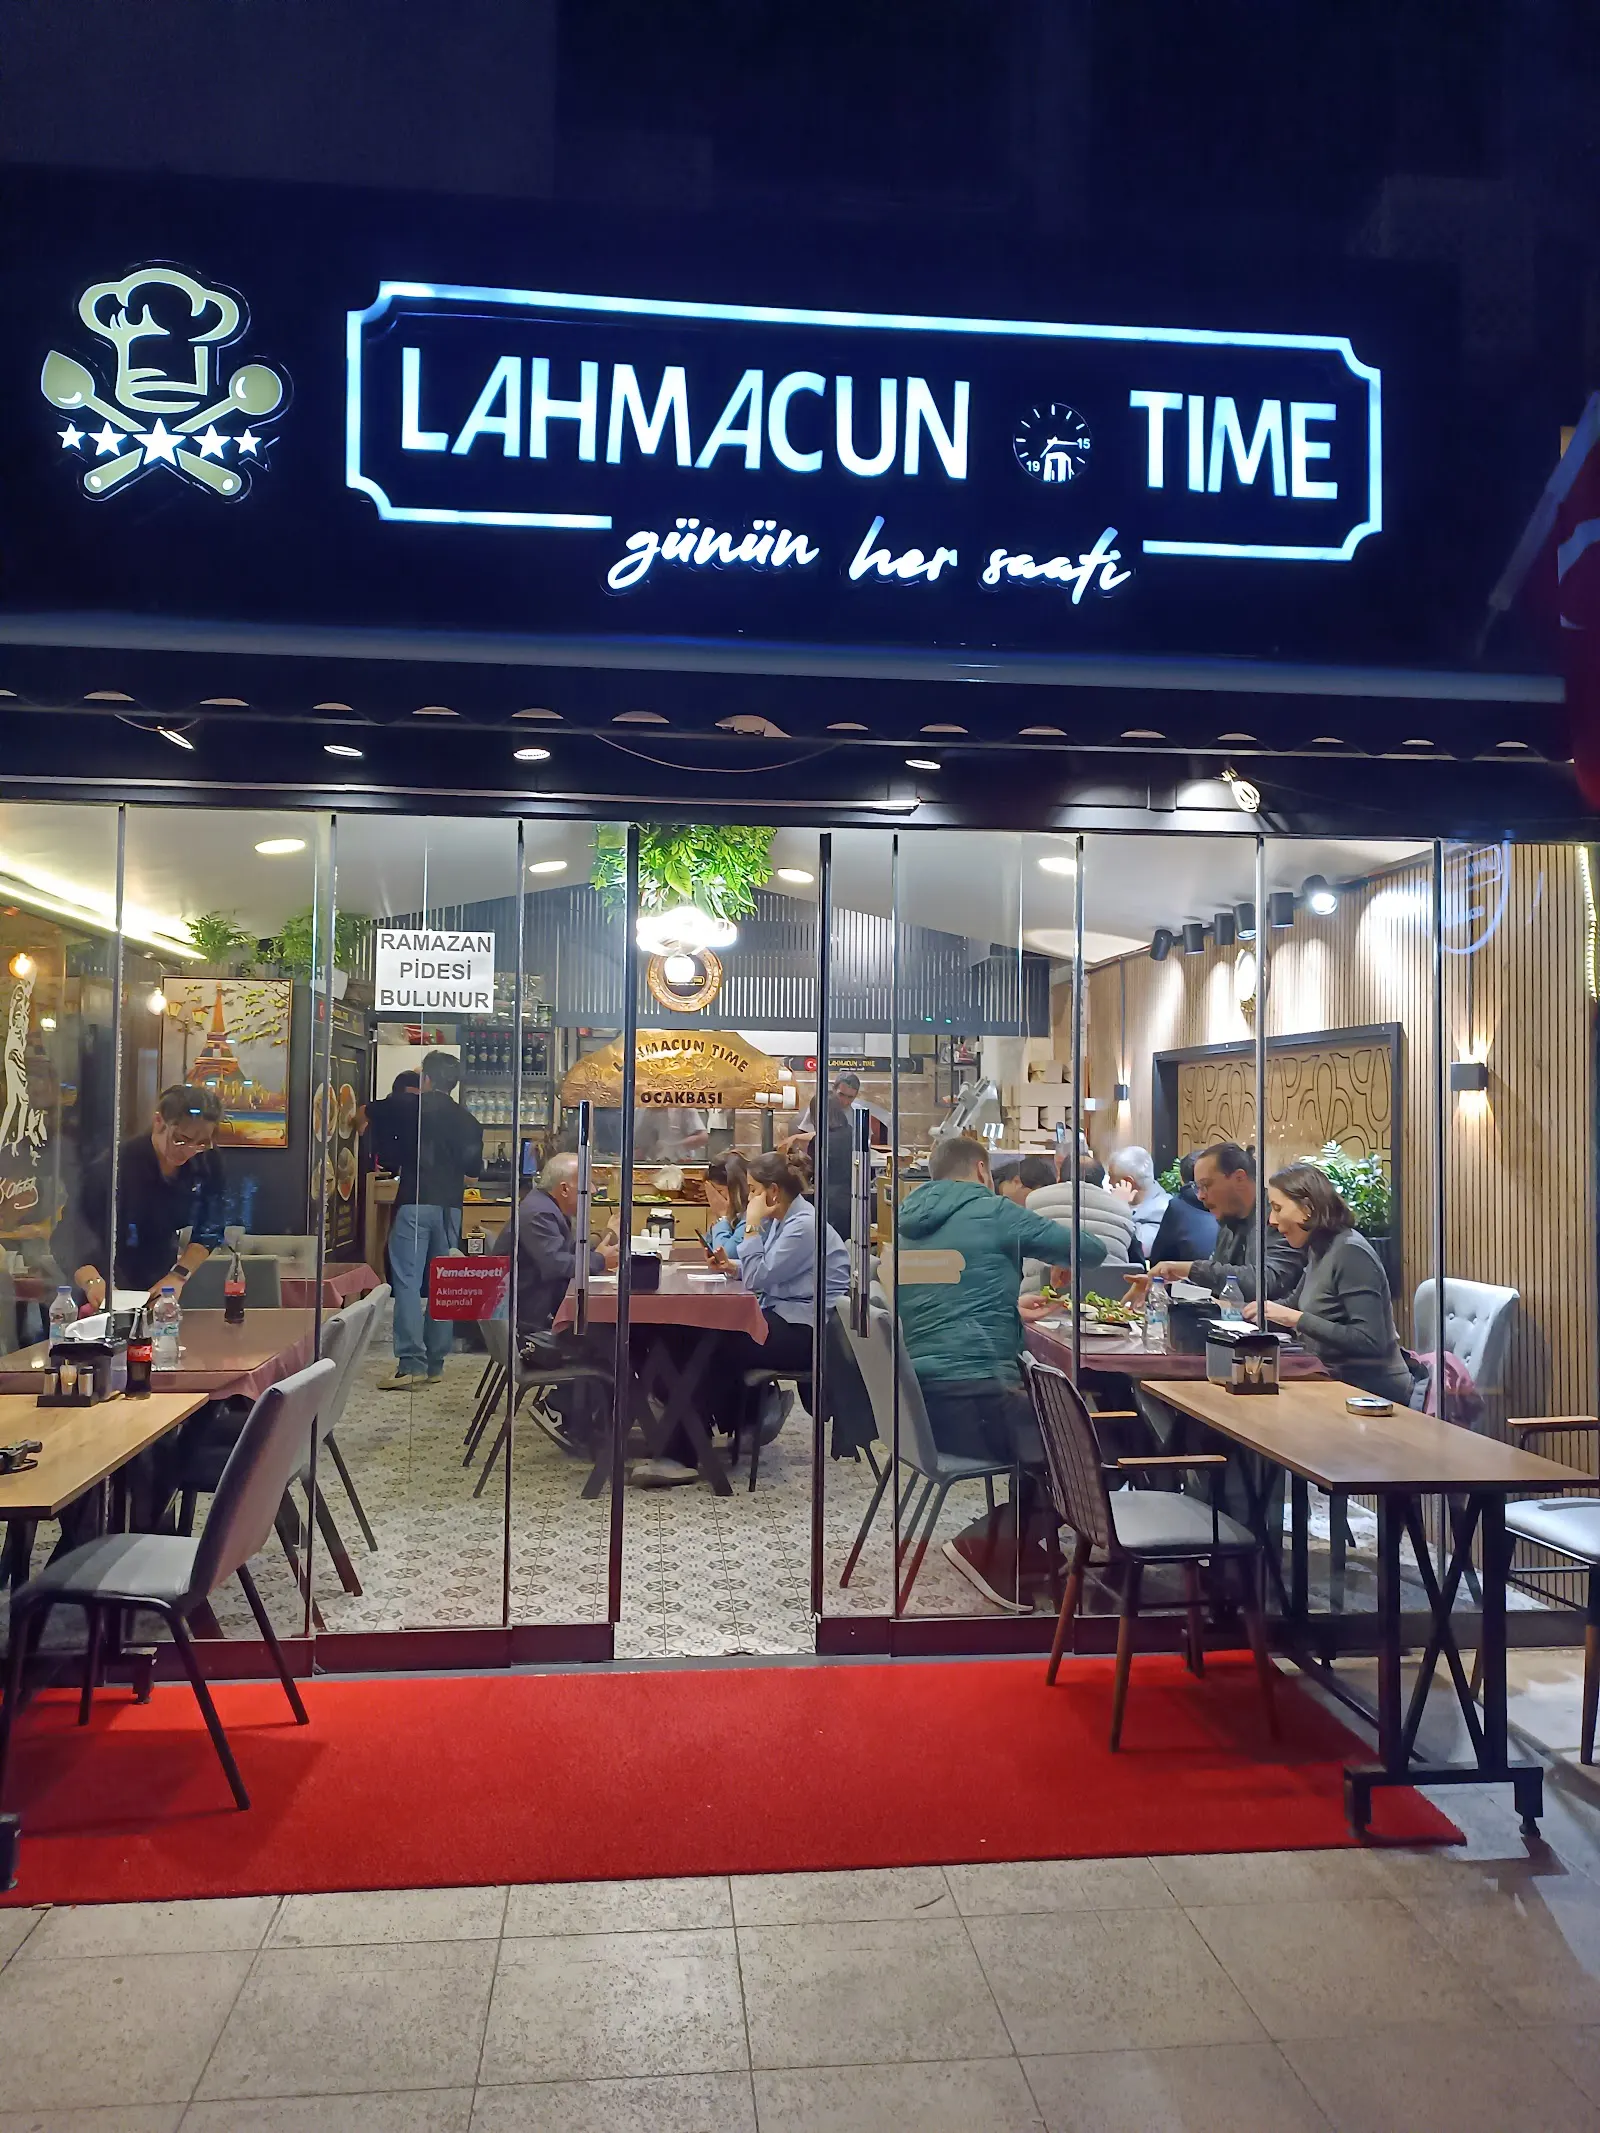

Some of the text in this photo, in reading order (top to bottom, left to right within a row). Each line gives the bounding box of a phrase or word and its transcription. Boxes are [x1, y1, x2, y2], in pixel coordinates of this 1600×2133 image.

[400, 347, 1339, 501] LAHMACUN TIME
[1077, 437, 1091, 450] 15
[1026, 460, 1041, 472] 19
[607, 515, 1133, 606] günün her saati
[380, 933, 491, 953] RAMAZAN
[400, 958, 471, 980] PİDESİ
[380, 989, 489, 1009] BULUNUR
[612, 1039, 749, 1073] LMACUN TIME
[640, 1091, 723, 1108] OCAKBAŞI
[436, 1266, 503, 1280] Yemeksepeti
